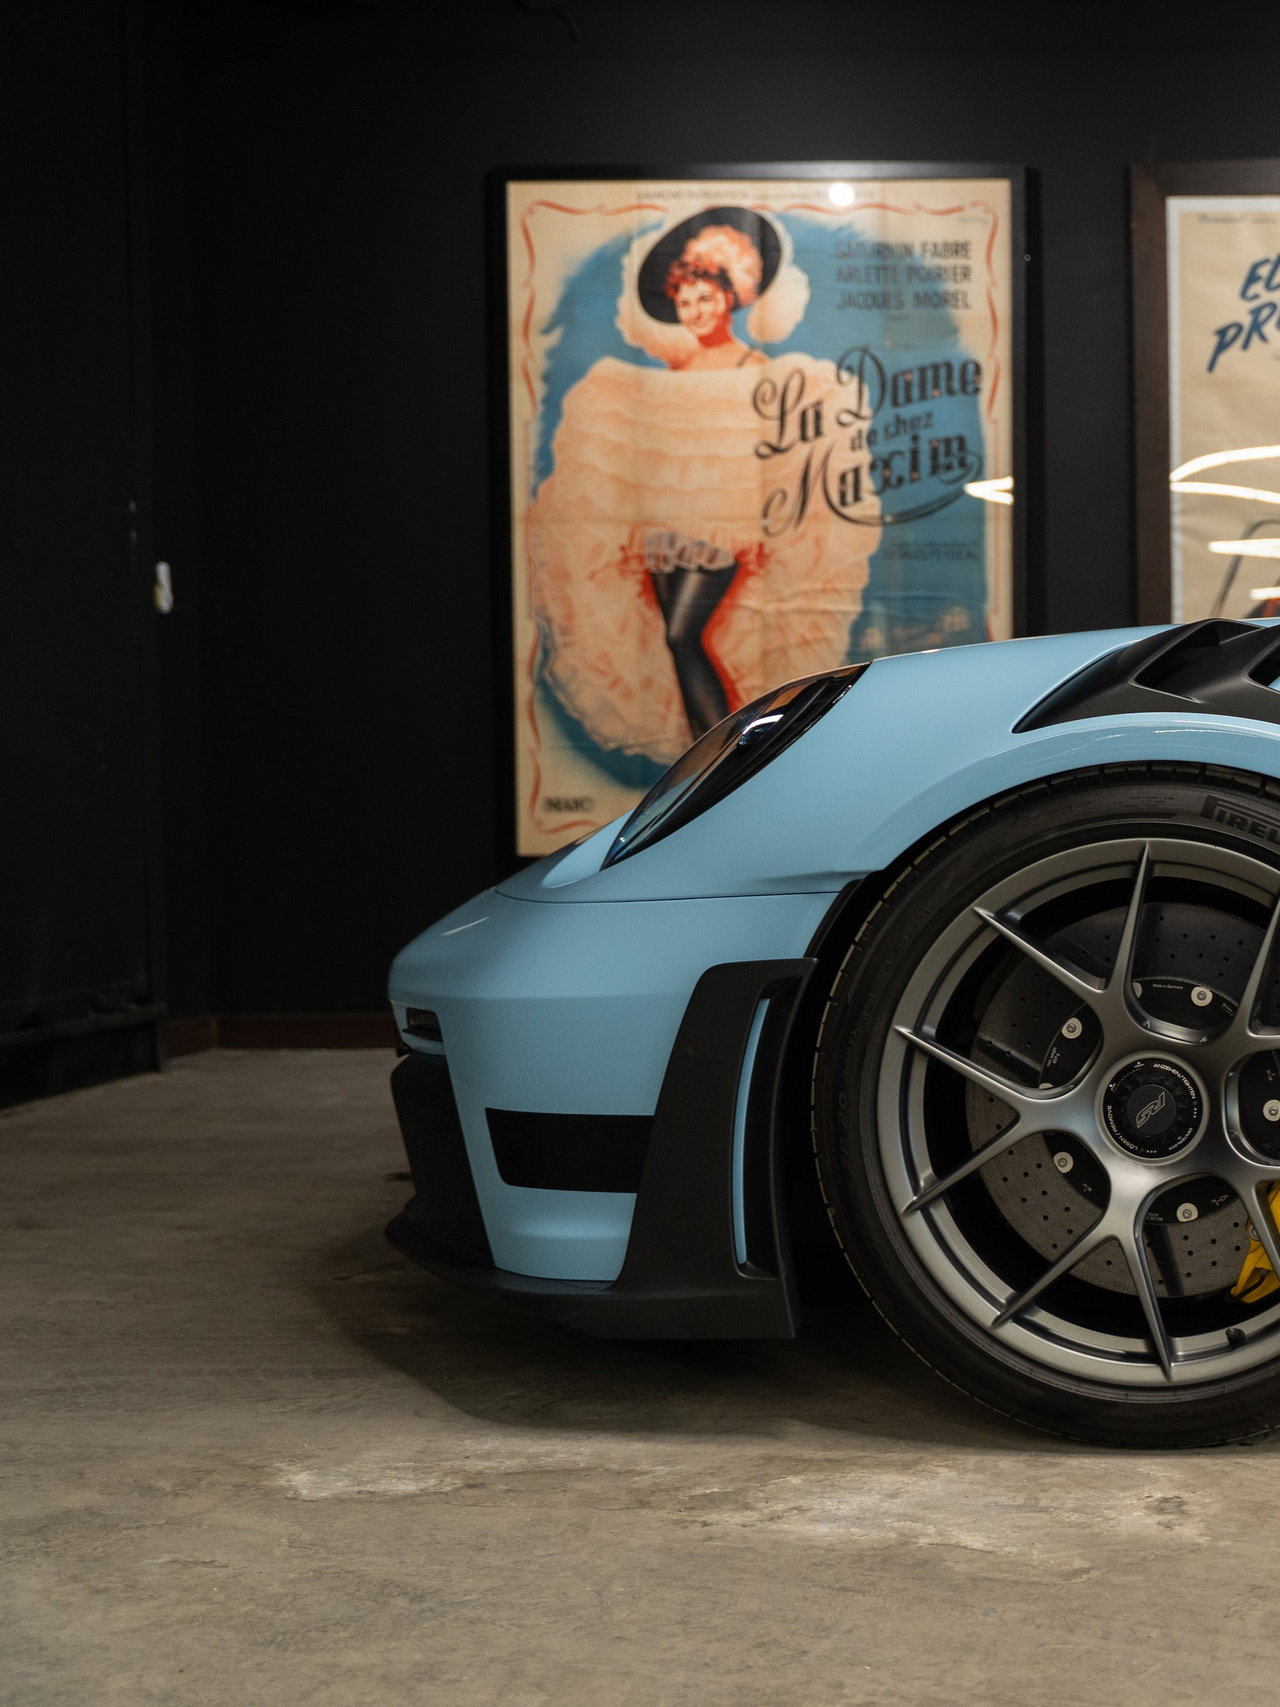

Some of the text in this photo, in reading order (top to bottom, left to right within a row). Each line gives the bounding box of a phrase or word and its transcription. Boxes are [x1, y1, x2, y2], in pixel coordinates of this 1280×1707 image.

[920, 241, 972, 260] FABRE
[835, 265, 972, 284] ARLETTE POIRIER
[835, 290, 971, 311] JACQUES MOREL
[752, 346, 983, 460] La Dame
[850, 409, 935, 451] de chez
[761, 432, 984, 540] Maxim
